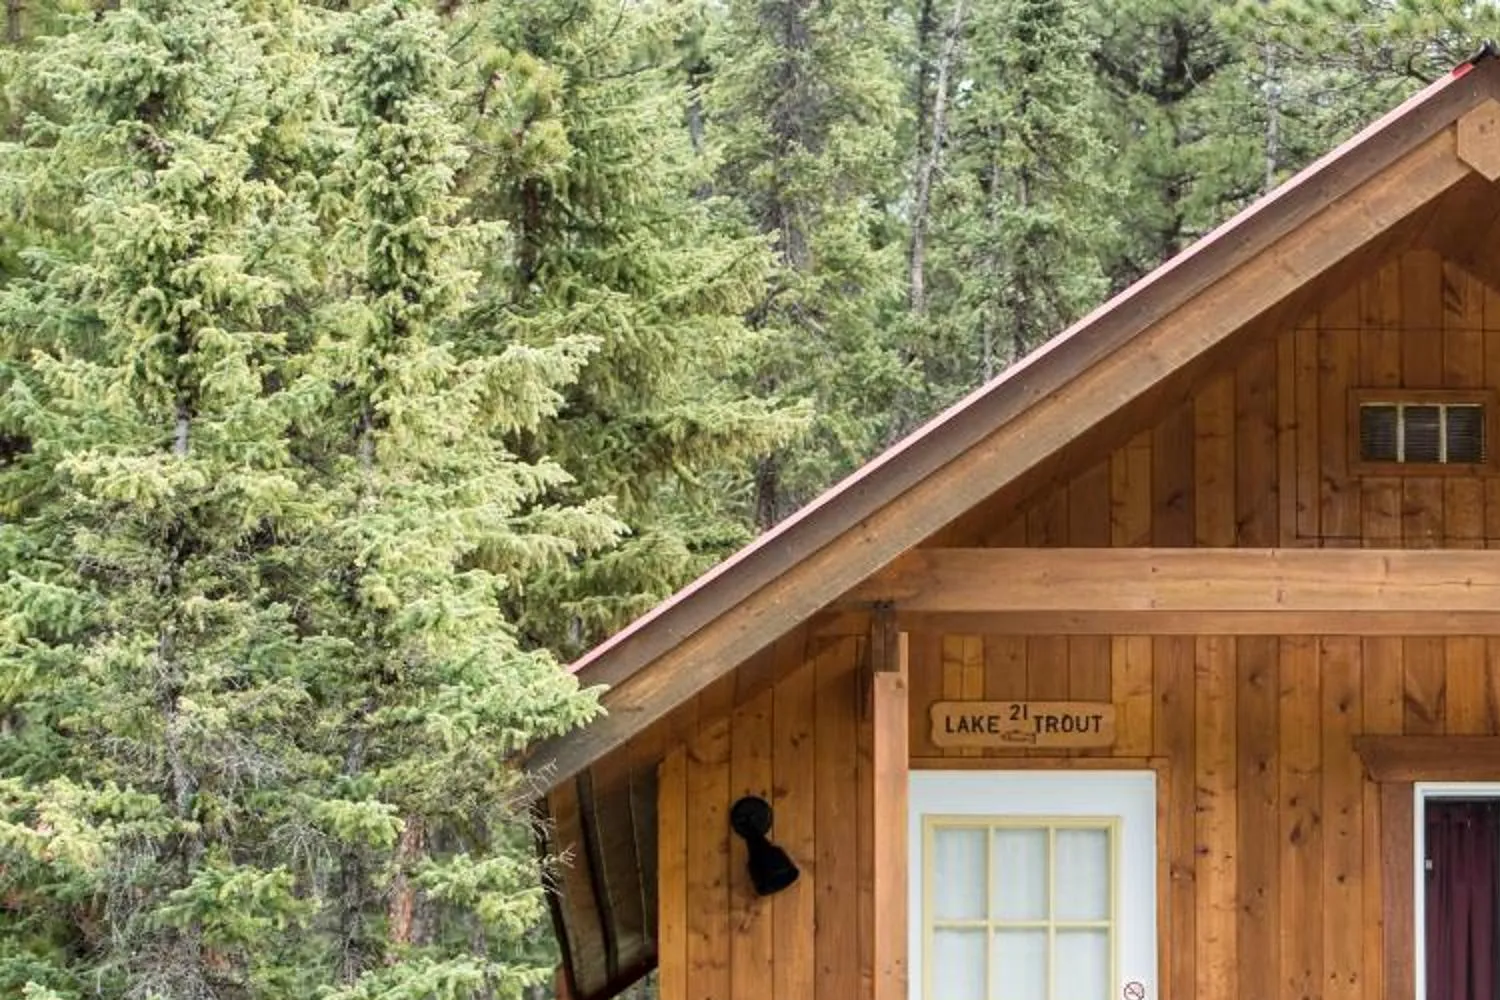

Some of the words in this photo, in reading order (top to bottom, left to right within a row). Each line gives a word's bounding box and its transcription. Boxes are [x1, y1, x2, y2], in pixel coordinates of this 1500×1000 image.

[1009, 704, 1028, 720] 21
[945, 715, 1000, 733] LAKE
[1033, 715, 1103, 733] TROUT
